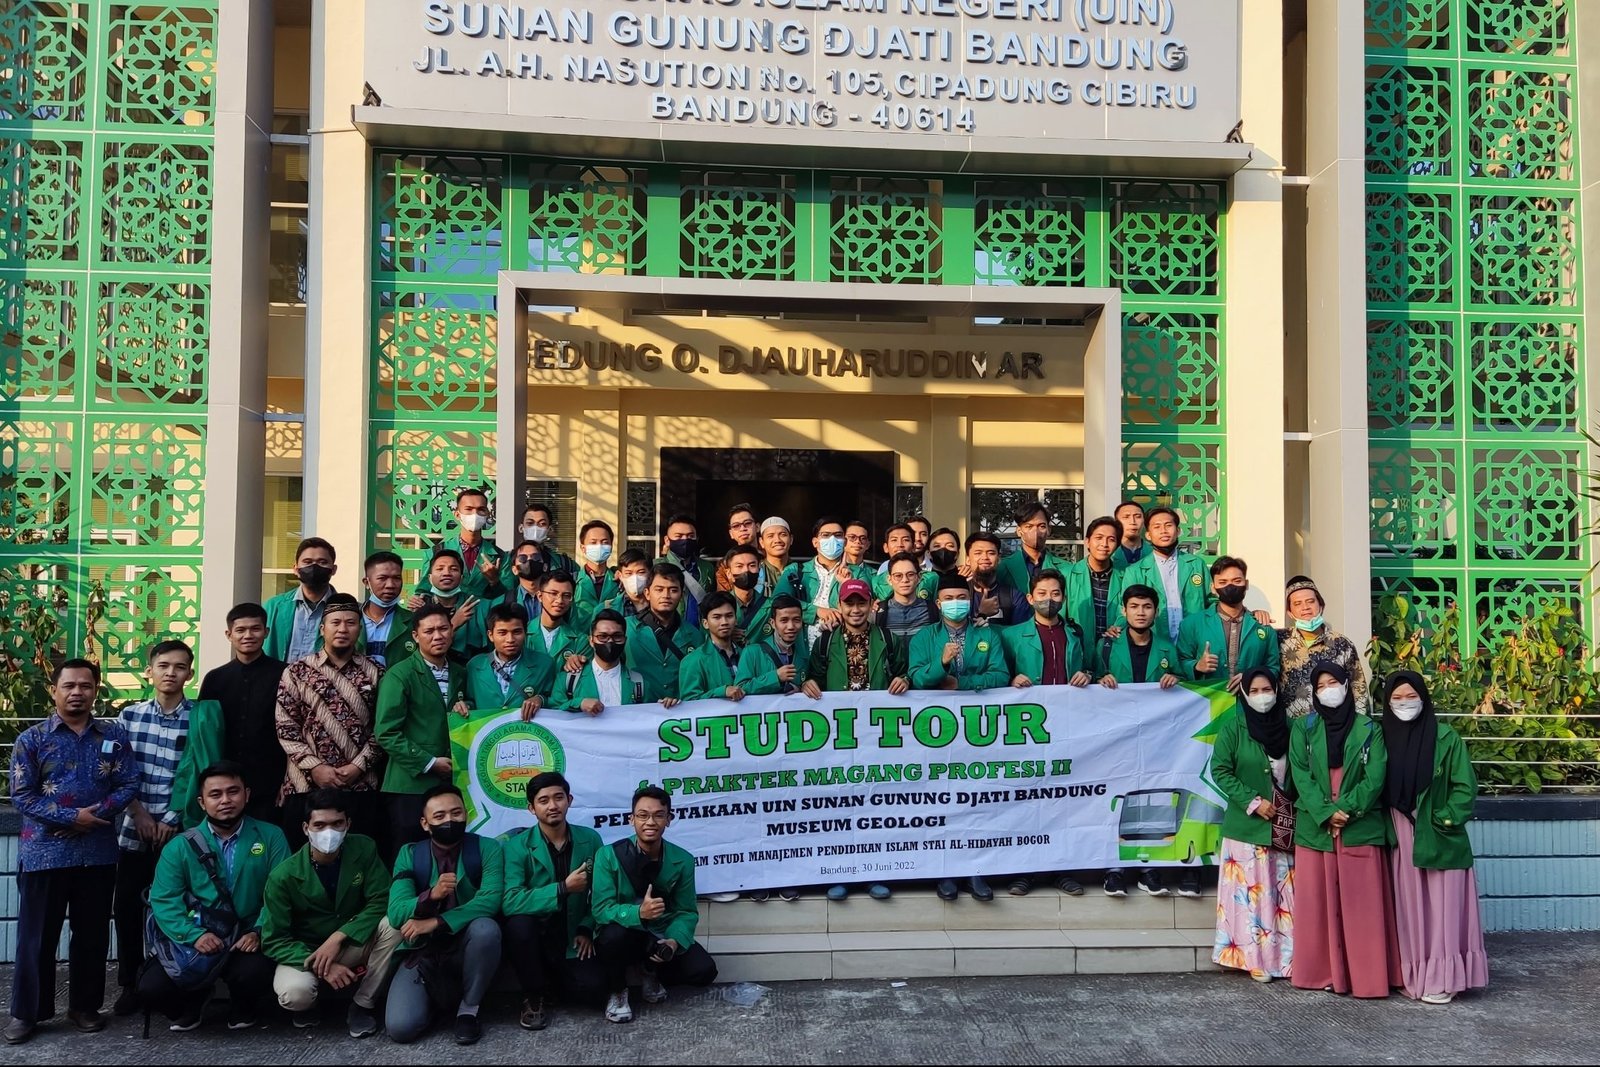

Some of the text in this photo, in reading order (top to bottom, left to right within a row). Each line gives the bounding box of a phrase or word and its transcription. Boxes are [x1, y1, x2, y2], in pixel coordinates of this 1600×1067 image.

[424, 1, 1187, 70] SUNAN GUNUNG DJATI BANDUNG
[1074, 0, 1174, 34] (UIN)
[412, 46, 468, 75] JL.
[563, 55, 752, 89] NASUTION
[760, 65, 815, 93] No.
[1080, 80, 1196, 109] CIBIRU
[651, 93, 836, 126] BANDUNG
[871, 103, 974, 131] 40614
[528, 340, 1045, 380] EDUNG O. DJAUHARUDDIN AR
[658, 703, 1050, 762] STUDI TOUR
[505, 782, 528, 793] STA
[662, 770, 797, 796] PRAKTEK
[803, 764, 922, 786] MAGANG
[929, 761, 1045, 780] PROFESI
[1051, 759, 1072, 775] II
[594, 784, 1106, 828] PERSTAKAAN UIN SUNAN GUNUNG DJATI BANDUNG
[767, 815, 946, 836] MUSEUM GEOLOGI
[713, 853, 744, 865] STUDI
[749, 847, 813, 862] MANAJEMEN
[817, 843, 882, 856] PENDIDIKAN
[886, 841, 918, 852] ISLAM
[922, 840, 946, 850] STAI
[950, 837, 1012, 849] AL-HIDAYAH
[1017, 835, 1050, 846] BOGOR
[820, 861, 915, 875] Bandung, 30 Juni 2022
